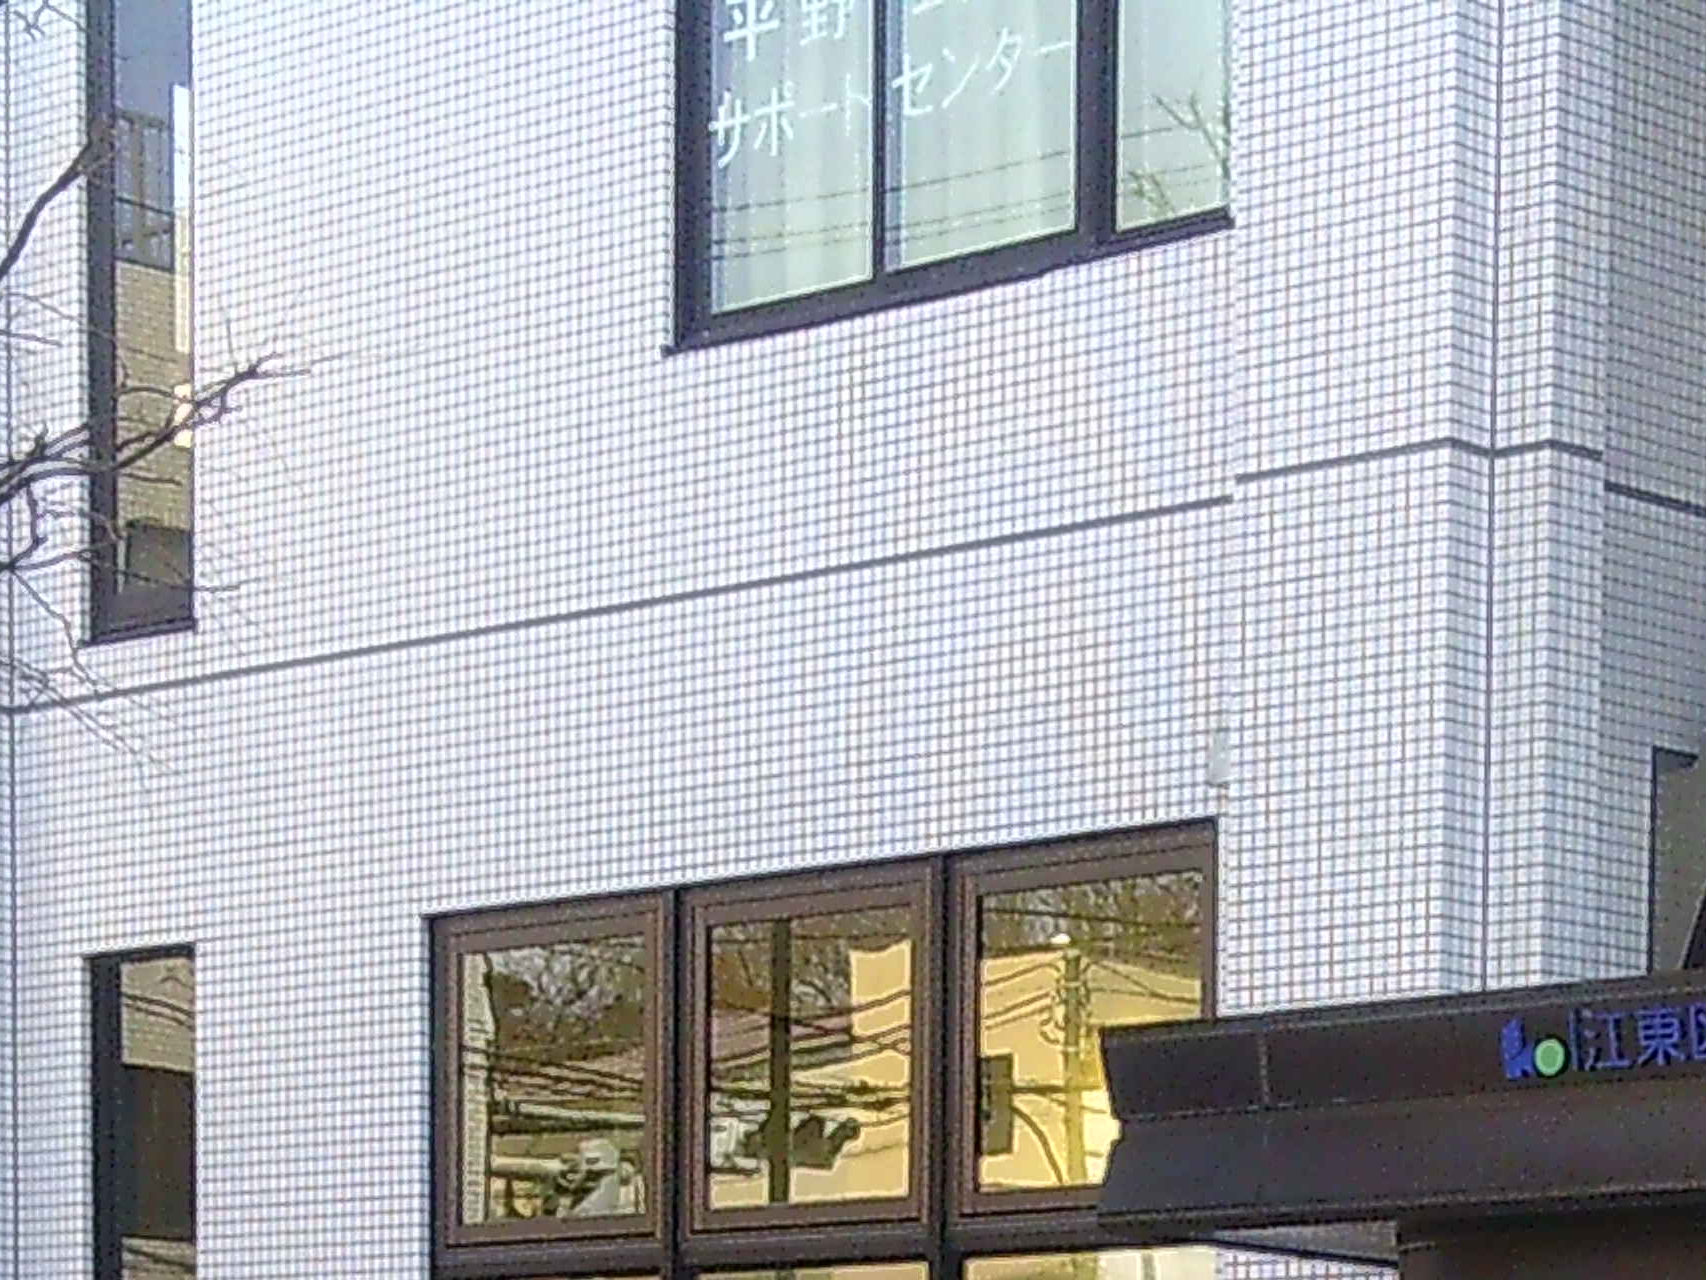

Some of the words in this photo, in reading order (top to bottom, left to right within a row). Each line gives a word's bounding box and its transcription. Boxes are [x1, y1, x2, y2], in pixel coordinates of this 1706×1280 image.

[709, 27, 1072, 168] サポートセンター
